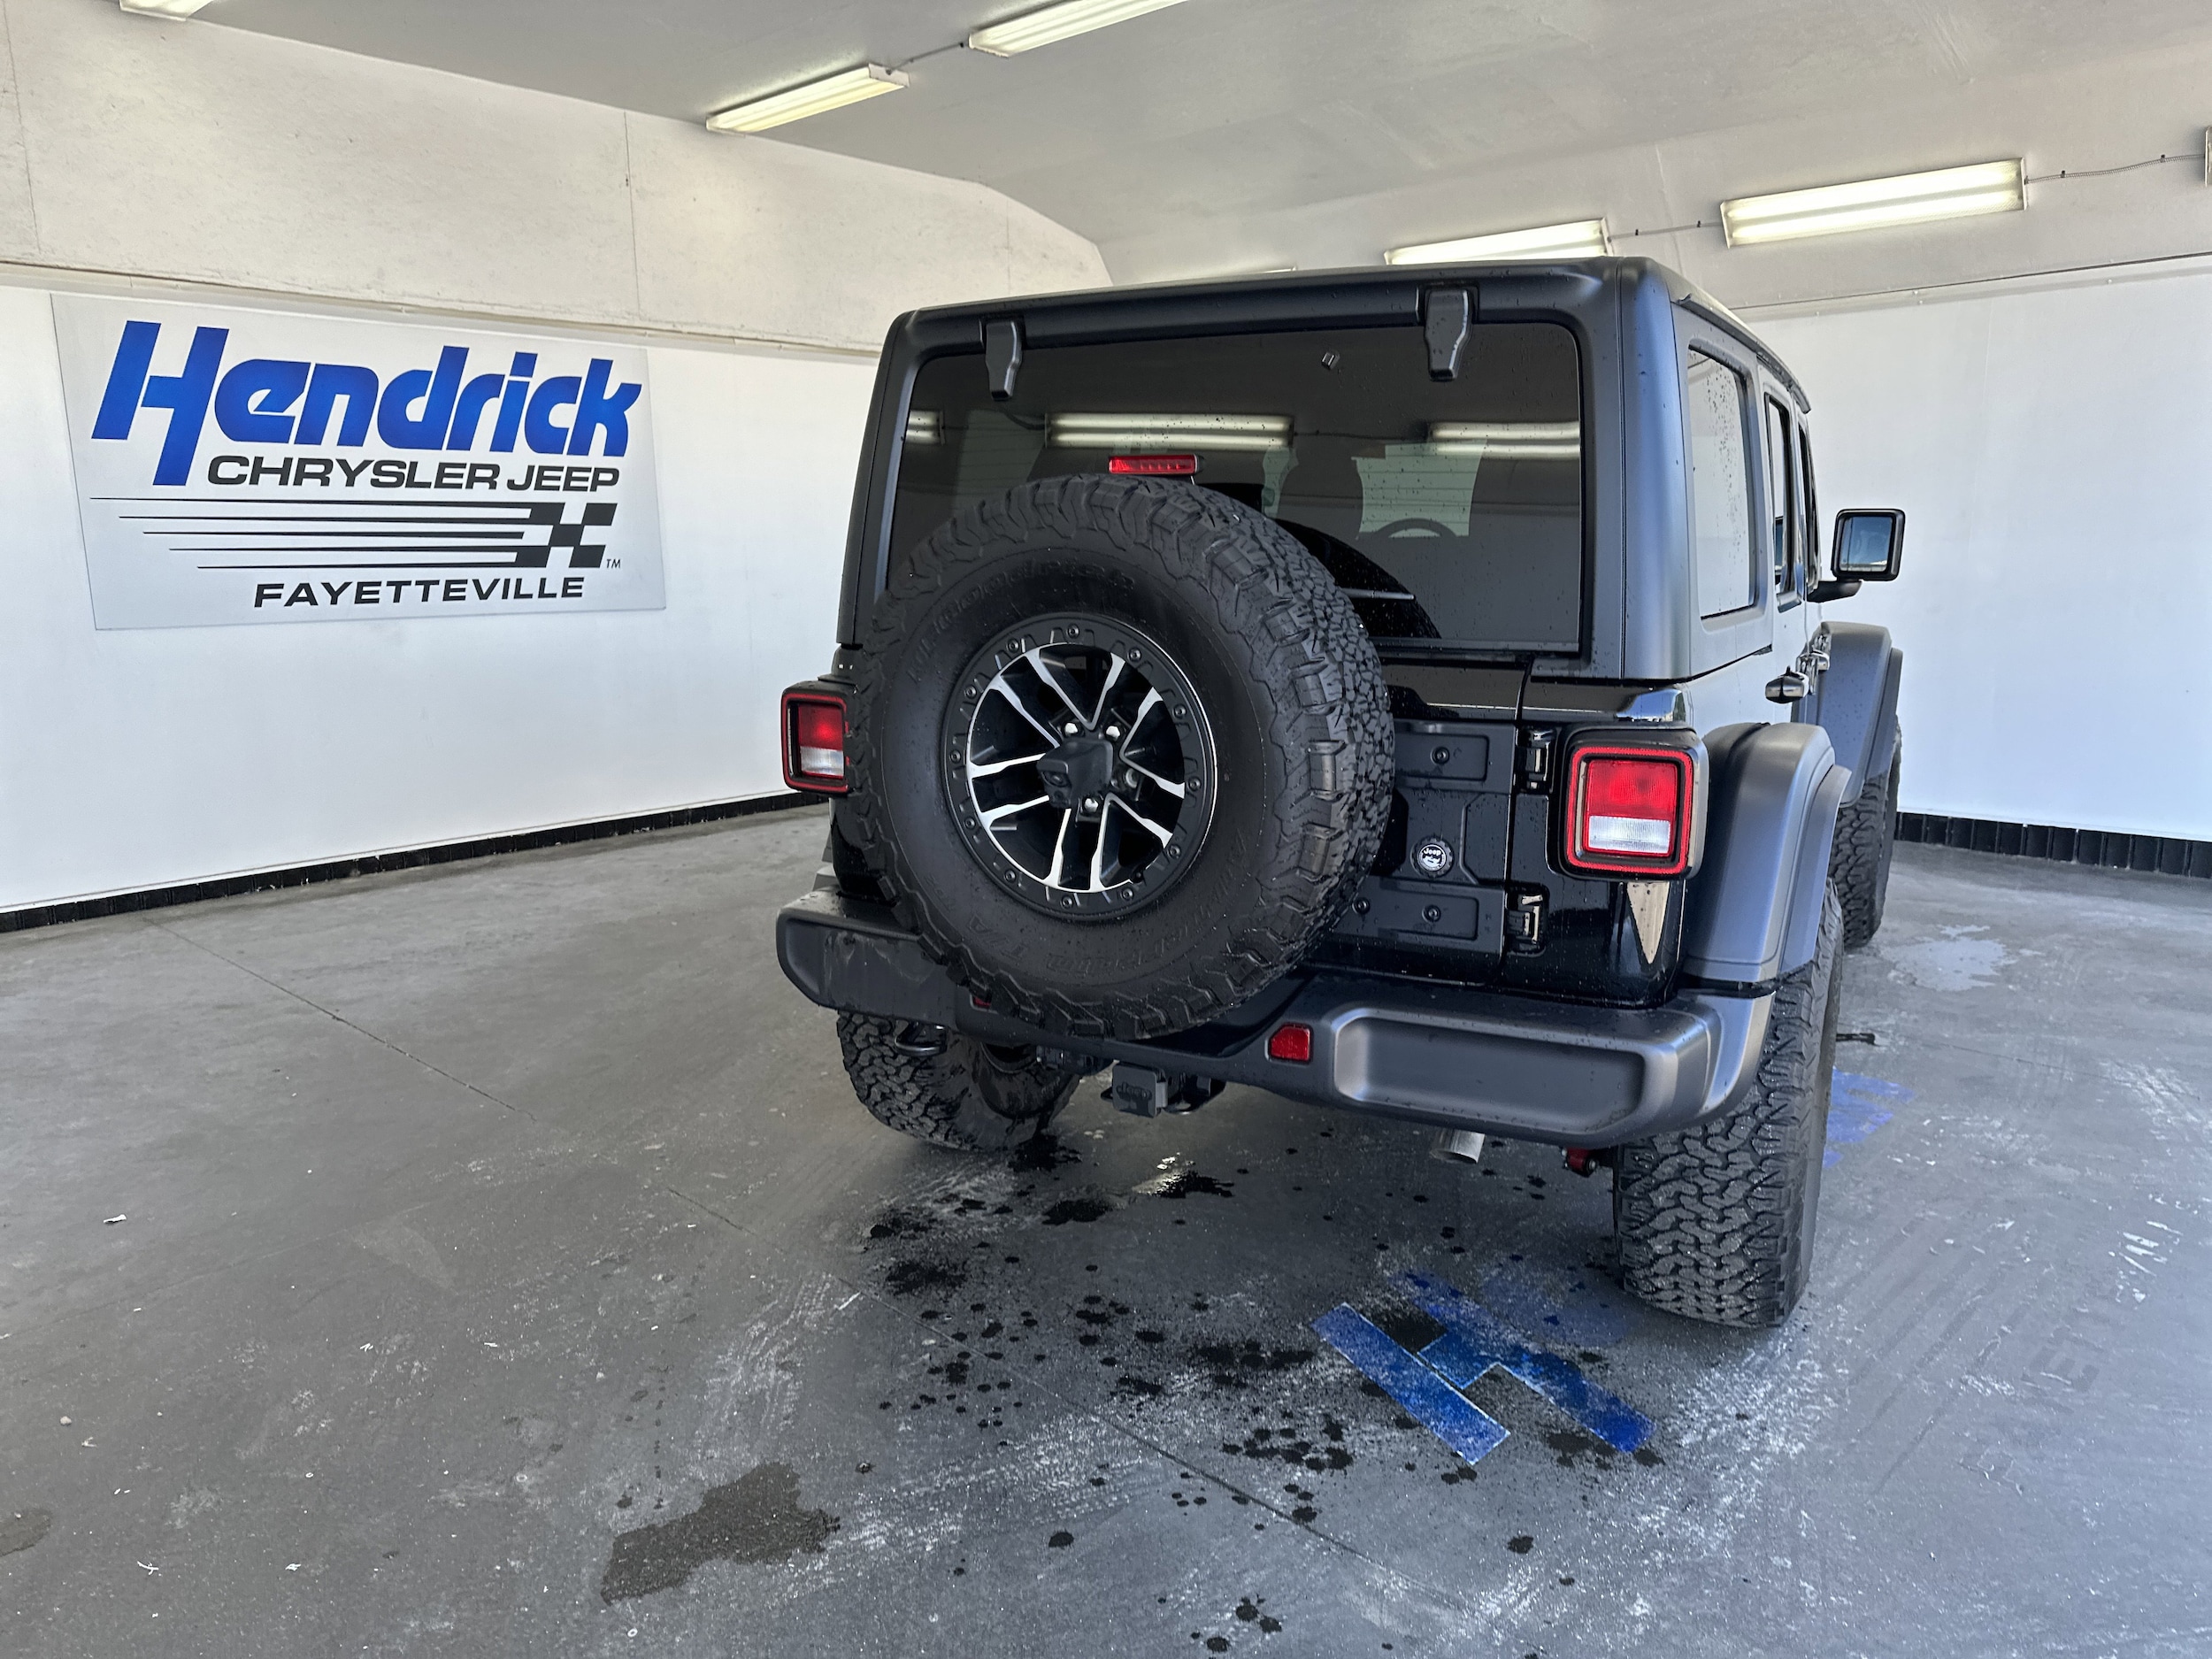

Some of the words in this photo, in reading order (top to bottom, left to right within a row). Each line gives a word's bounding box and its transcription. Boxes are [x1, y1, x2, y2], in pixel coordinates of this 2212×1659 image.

[92, 320, 641, 485] Hendrick
[208, 455, 501, 489] CHRYSLER
[507, 465, 619, 491] JEEP
[606, 558, 620, 569] TM
[254, 577, 585, 608] FAYETTEVILLE
[1424, 847, 1441, 856] Jeep
